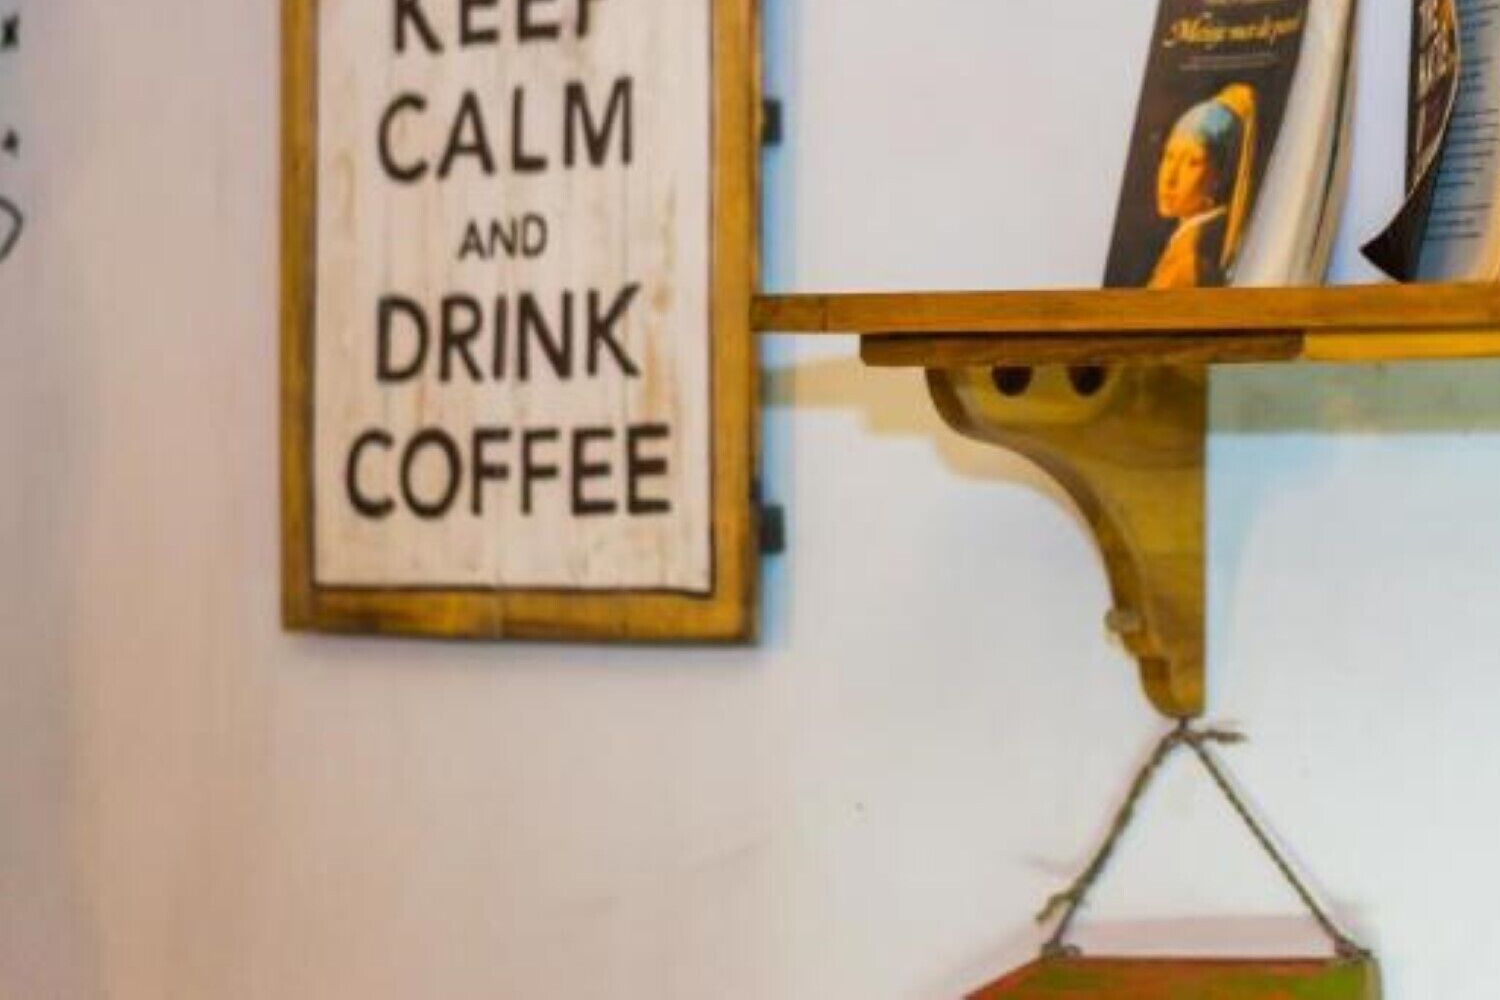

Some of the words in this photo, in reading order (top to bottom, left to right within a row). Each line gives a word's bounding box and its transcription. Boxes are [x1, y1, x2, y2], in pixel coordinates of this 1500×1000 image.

[377, 76, 633, 185] CALM
[458, 213, 547, 259] AND
[375, 283, 639, 384] DRINK
[343, 421, 672, 521] COFFEE
